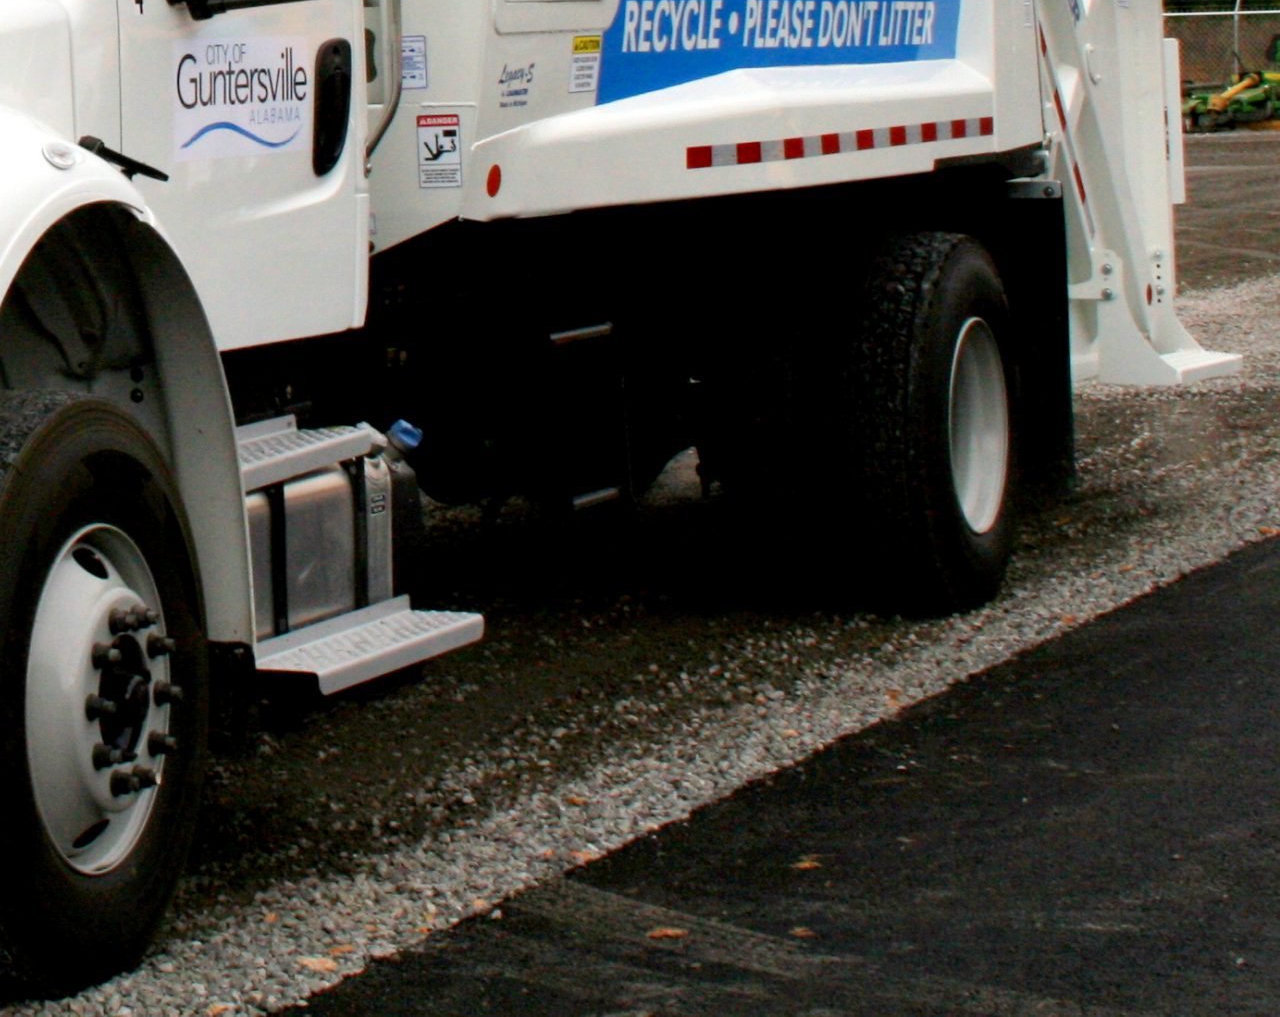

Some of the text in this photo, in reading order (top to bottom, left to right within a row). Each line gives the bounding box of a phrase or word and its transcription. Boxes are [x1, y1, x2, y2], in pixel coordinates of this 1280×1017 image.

[817, 0, 878, 47] DON'T
[878, 0, 936, 46] LITTER
[206, 43, 247, 65] CITY OF
[176, 47, 307, 110] Guntersville
[249, 106, 301, 126] ALABAMA
